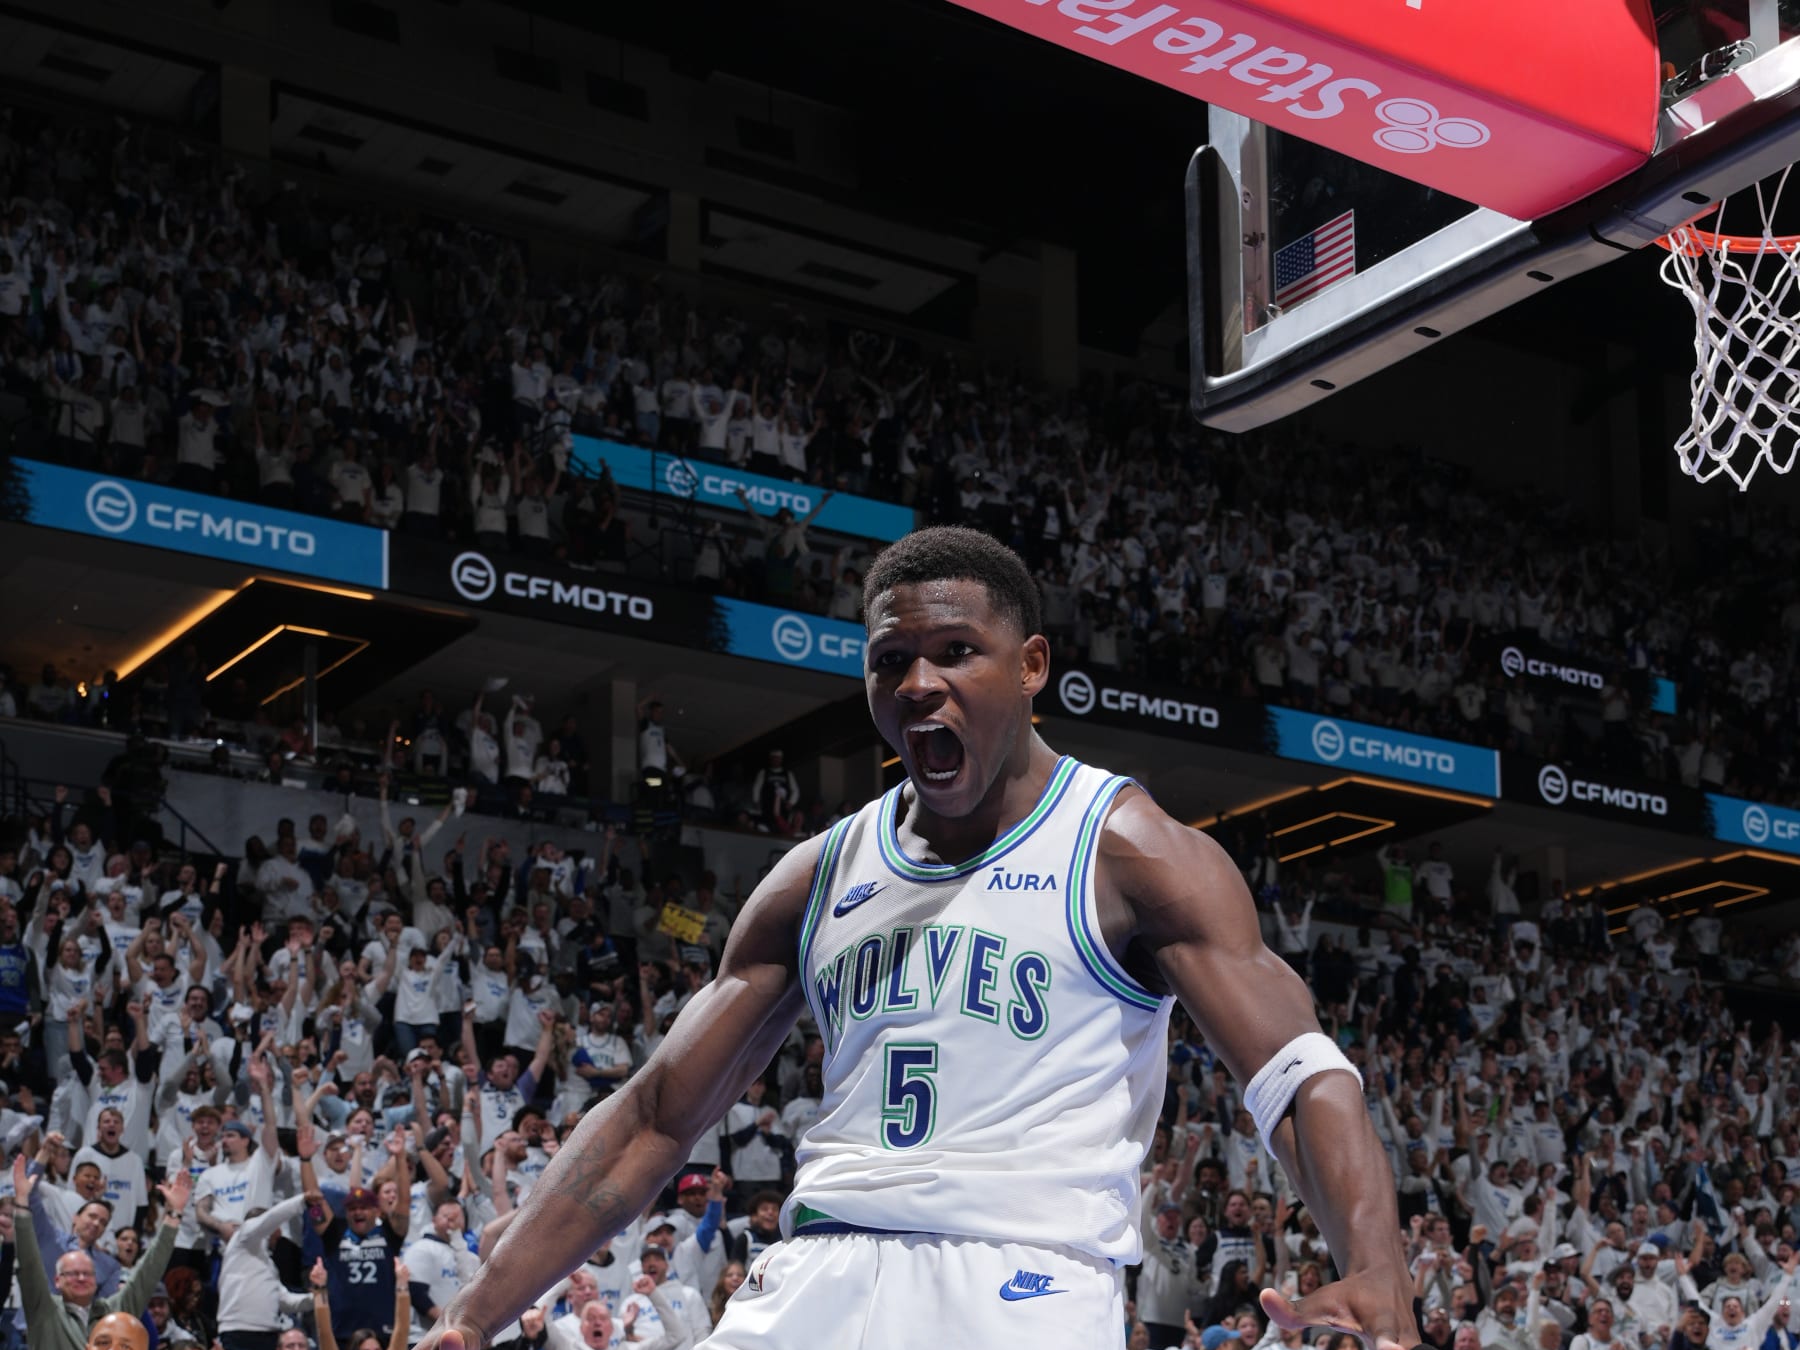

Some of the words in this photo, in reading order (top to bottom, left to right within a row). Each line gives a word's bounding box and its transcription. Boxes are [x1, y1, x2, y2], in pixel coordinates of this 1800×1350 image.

[1153, 23, 1382, 120] State
[703, 475, 812, 513] CFMOTO
[146, 502, 316, 557] CFMOTO
[504, 571, 654, 621] CFMOTO
[819, 633, 868, 660] CF
[1100, 687, 1219, 729] CFMOTO
[1349, 736, 1456, 775] CFMOTO
[1571, 779, 1668, 816] CFMOTO
[844, 880, 878, 902] NIKE
[814, 925, 1053, 1055] WOLVES
[880, 1041, 939, 1151] 5
[348, 1260, 378, 1284] 32
[1010, 1269, 1055, 1293] NIKE
